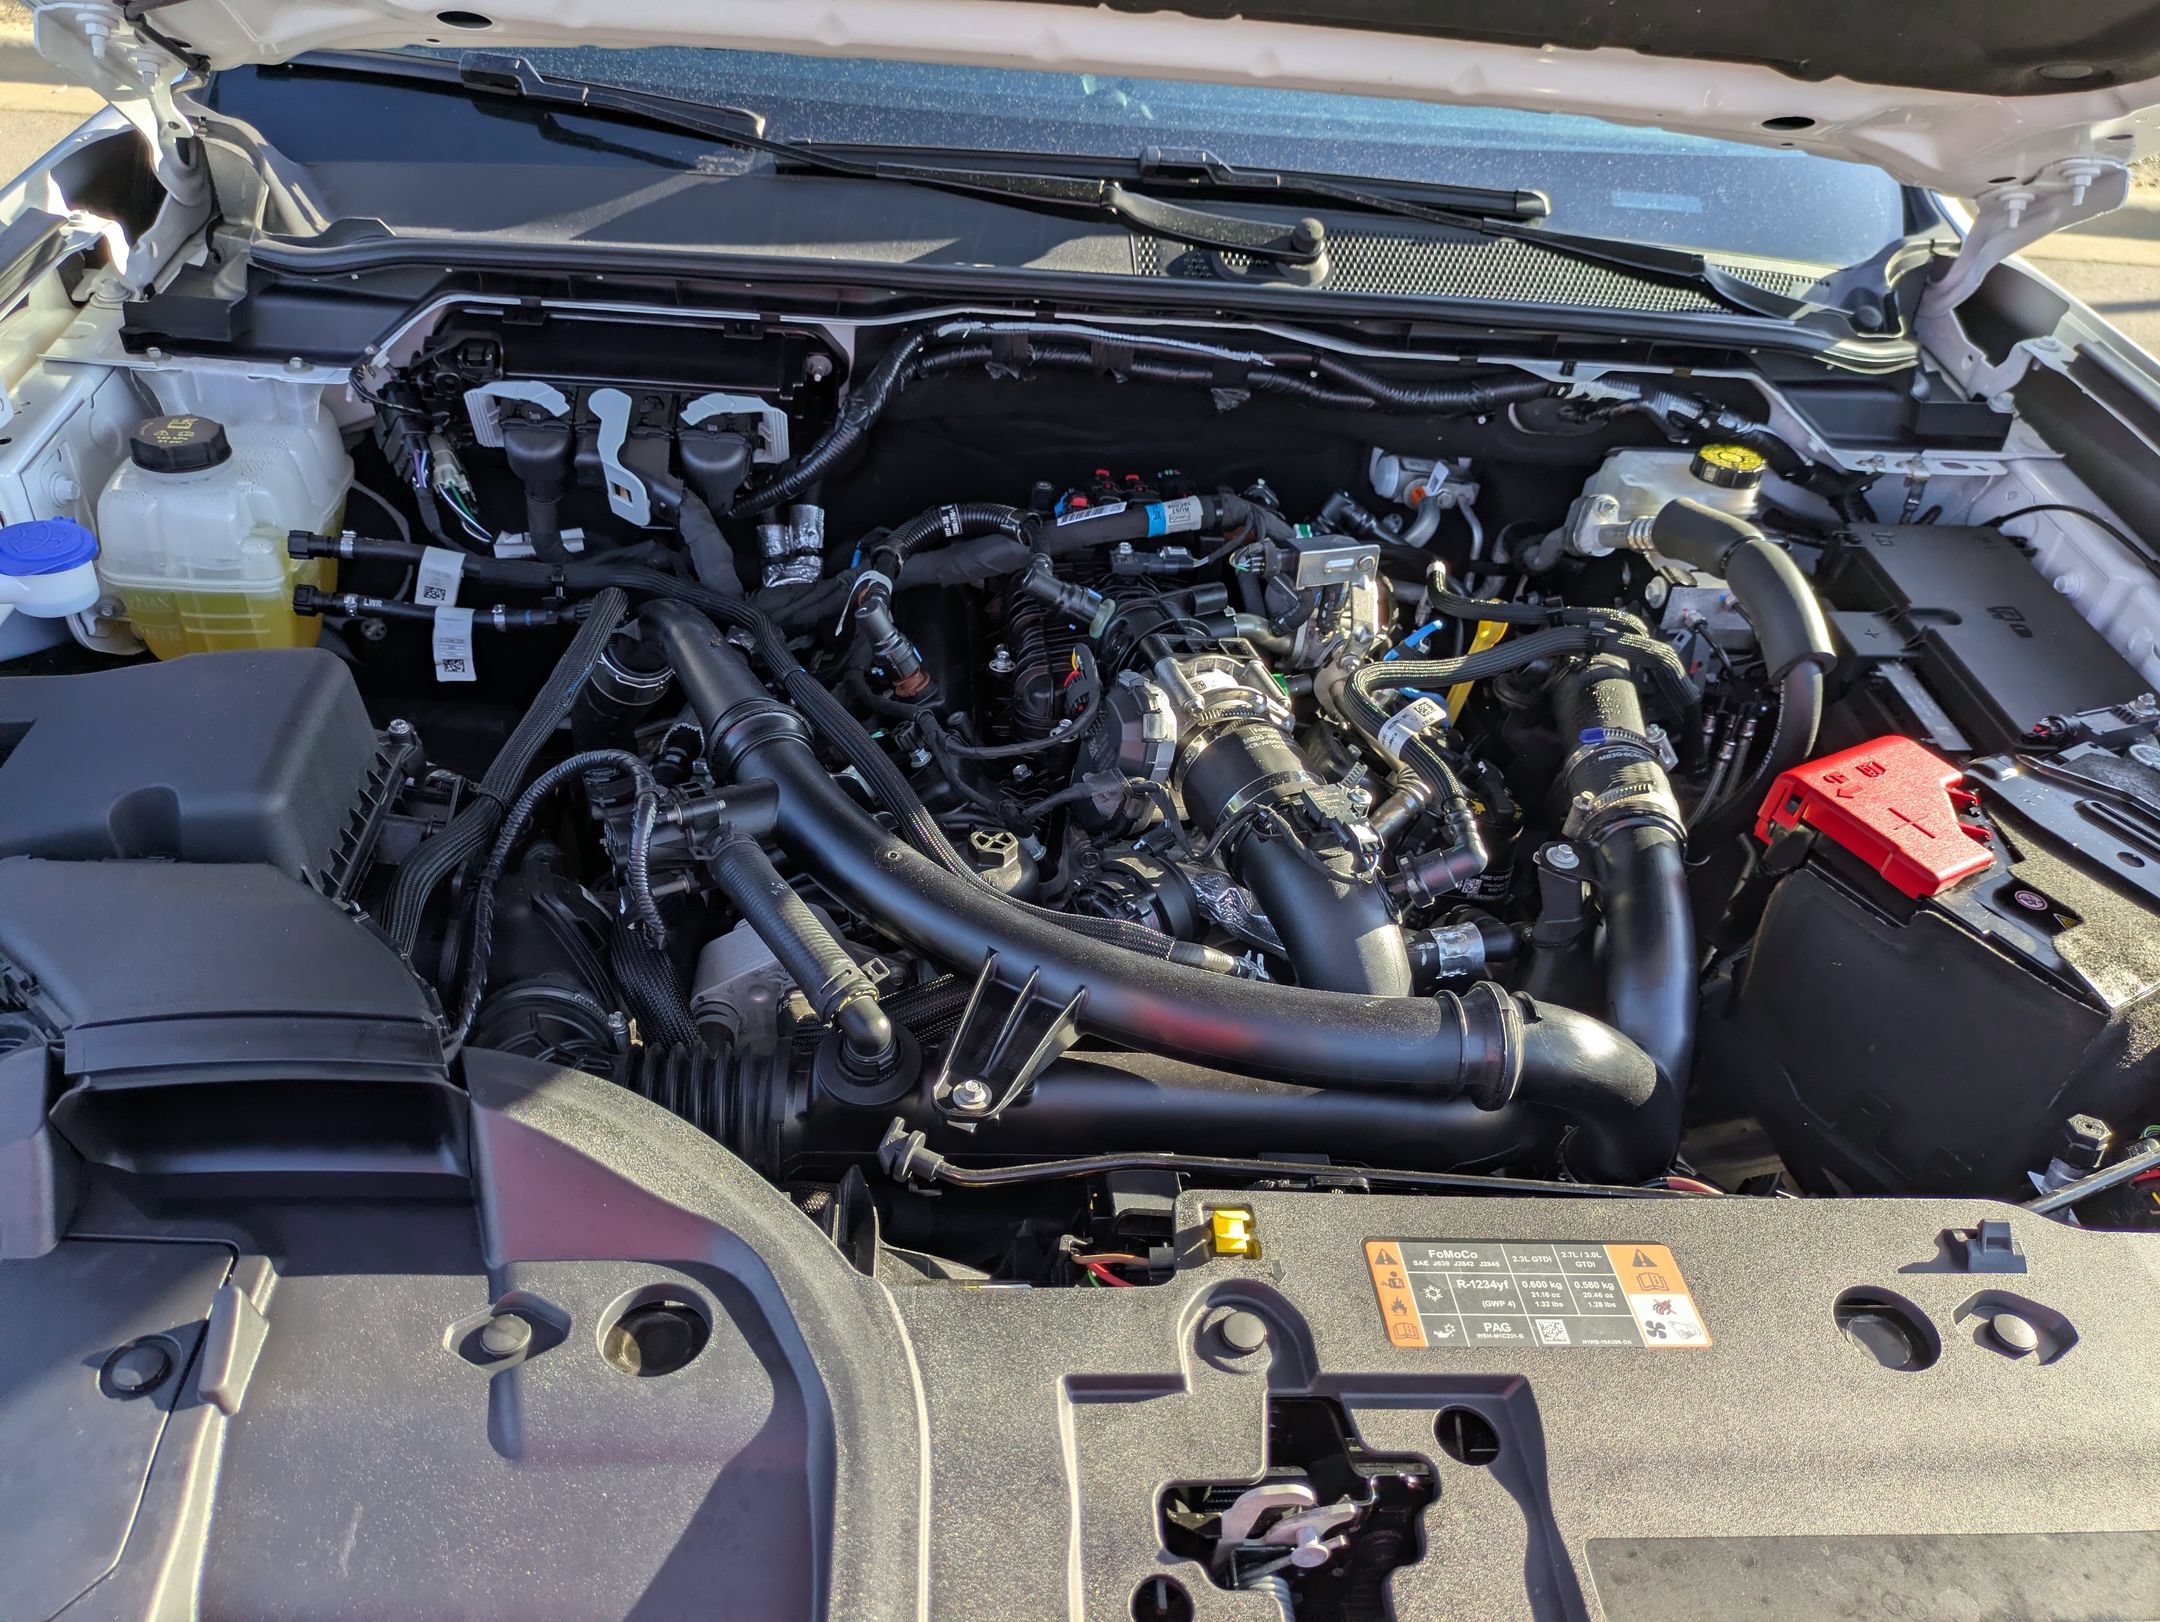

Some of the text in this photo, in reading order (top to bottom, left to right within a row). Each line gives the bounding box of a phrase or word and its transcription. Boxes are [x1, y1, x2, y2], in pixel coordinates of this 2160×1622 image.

[363, 598, 383, 608] LWR
[1428, 1250, 1478, 1259] FoMoCo
[1576, 1260, 1596, 1268] GTDI
[1456, 1280, 1510, 1291] R-1234yf
[1549, 1281, 1562, 1290] kg
[1574, 1281, 1614, 1290] 0.580 kg
[1482, 1300, 1516, 1309] (GWP 4)
[1483, 1322, 1512, 1332] PAG
